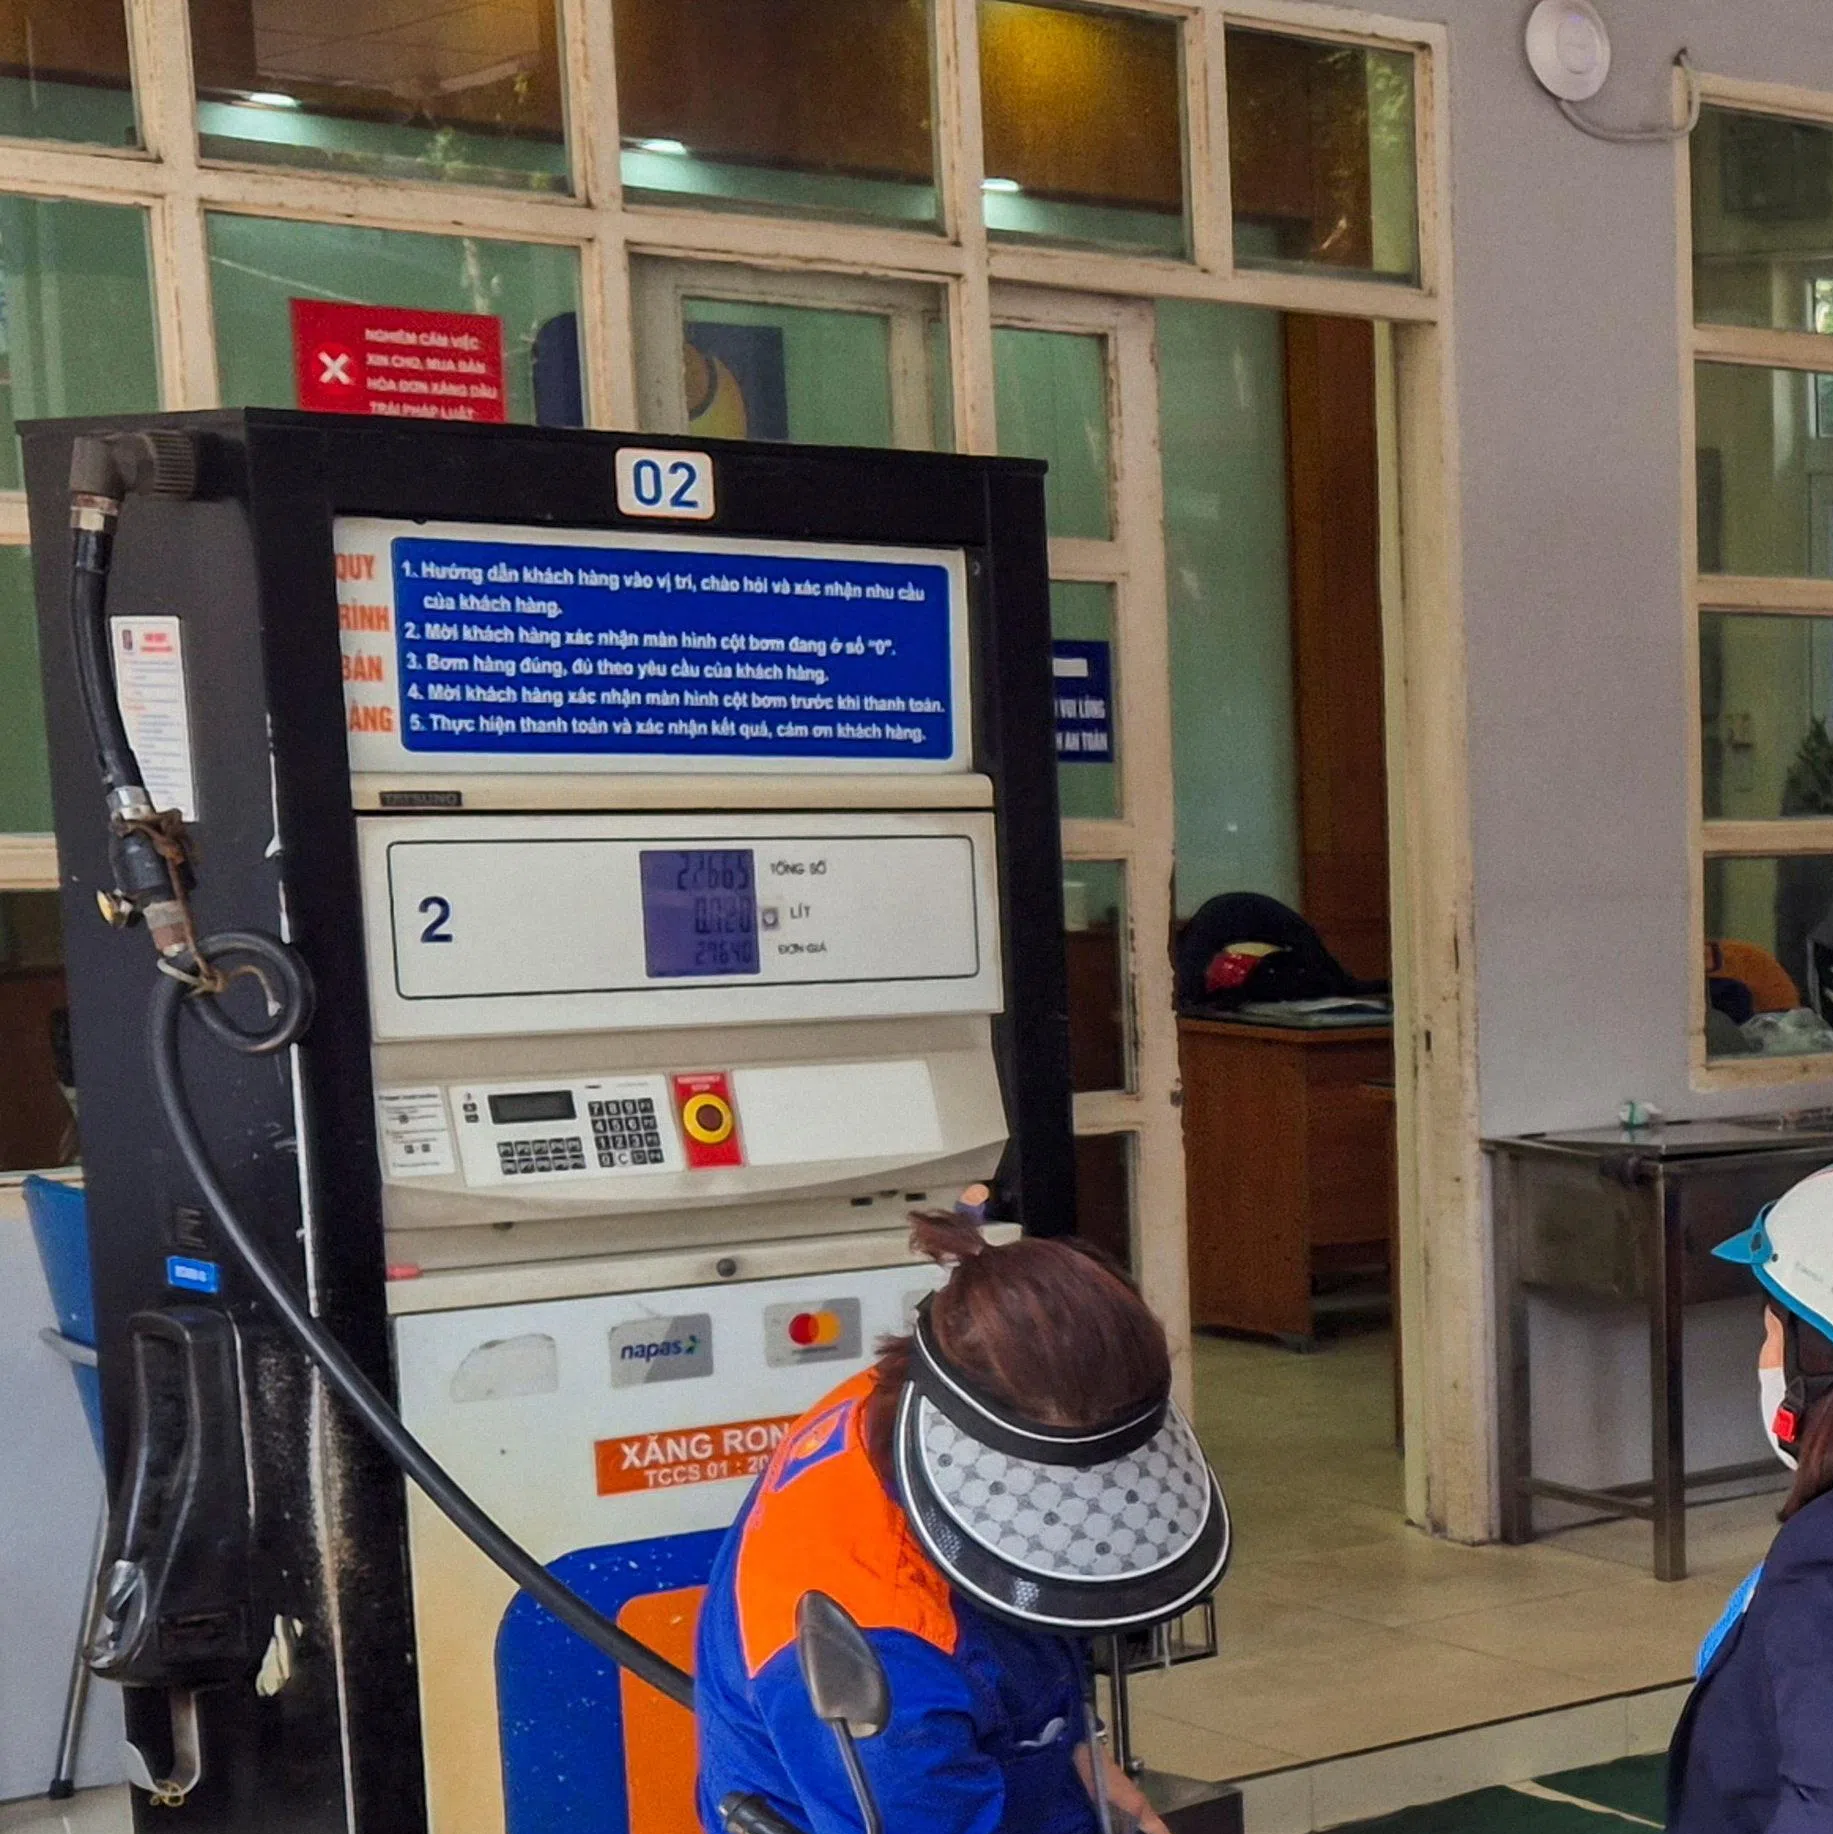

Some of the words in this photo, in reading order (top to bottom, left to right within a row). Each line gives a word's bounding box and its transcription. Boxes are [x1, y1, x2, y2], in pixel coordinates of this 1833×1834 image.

[632, 458, 699, 509] 02
[402, 560, 418, 578] 1.
[523, 567, 573, 585] khách
[578, 569, 619, 590] hàng
[825, 581, 861, 600] nhận
[866, 585, 894, 600] nhu
[339, 599, 389, 632] RÌNH
[459, 594, 511, 612] khách
[404, 622, 420, 640] 2.
[463, 624, 514, 642] khách
[519, 625, 561, 648] hàng
[598, 627, 638, 649] nhận
[407, 652, 422, 670] 3.
[473, 656, 515, 677] hàng
[598, 661, 633, 676] theo
[736, 662, 782, 680] khách
[407, 683, 423, 699] 4.
[466, 684, 516, 702] khách
[521, 685, 563, 707] hàng
[601, 687, 641, 709] nhận
[837, 695, 860, 711] khi
[864, 696, 905, 711] thanh
[350, 699, 394, 732] ÀNG
[410, 714, 427, 731] 5.
[520, 716, 567, 733] thanh
[668, 719, 707, 739] nhận
[837, 723, 881, 740] khách
[419, 896, 453, 943] 2
[620, 1340, 683, 1362] napas
[620, 1432, 712, 1470] XĂNG
[724, 1422, 790, 1455] RON
[644, 1463, 700, 1488] TCCS
[706, 1460, 728, 1478] 01
